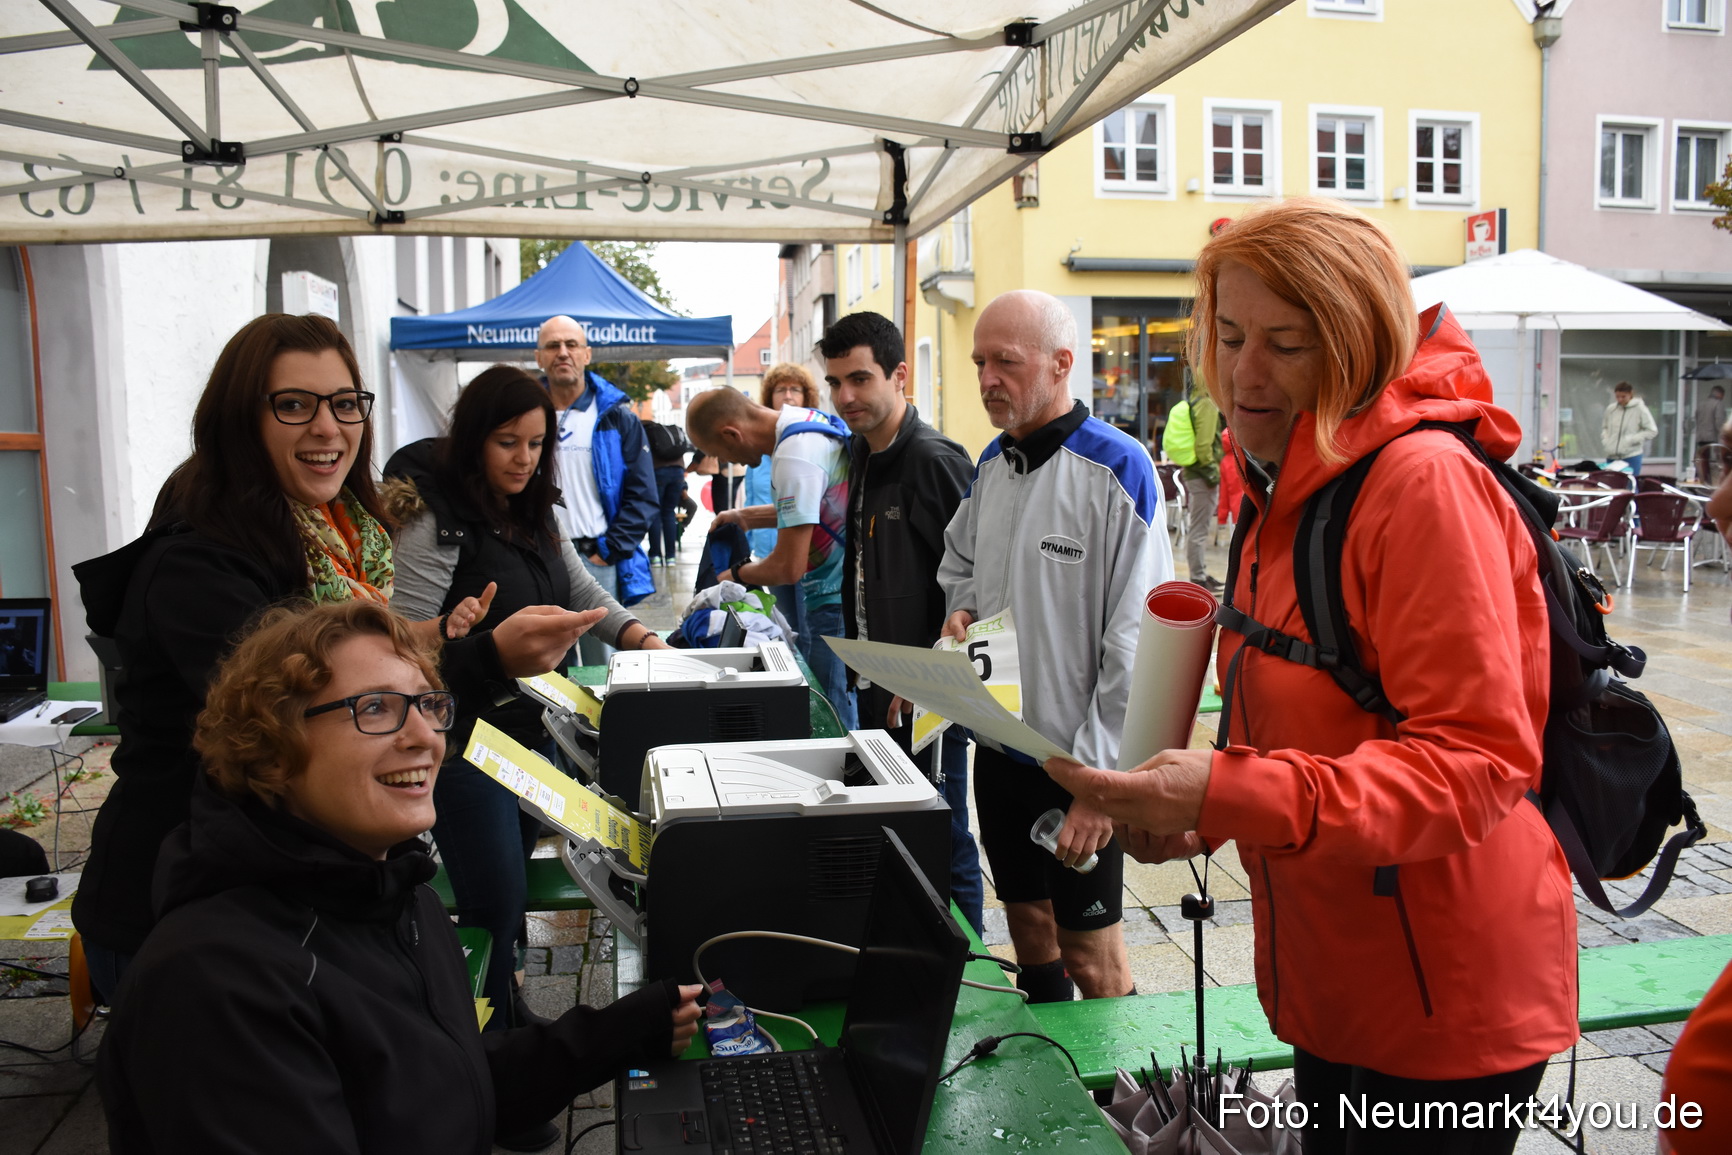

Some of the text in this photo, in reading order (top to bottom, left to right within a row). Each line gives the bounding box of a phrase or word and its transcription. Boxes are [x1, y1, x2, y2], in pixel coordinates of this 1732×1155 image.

[467, 322, 657, 343] Neumar Tagblatt
[1040, 541, 1083, 559] DYNAMITT
[968, 640, 992, 682] 5
[1082, 908, 1107, 917] adidas
